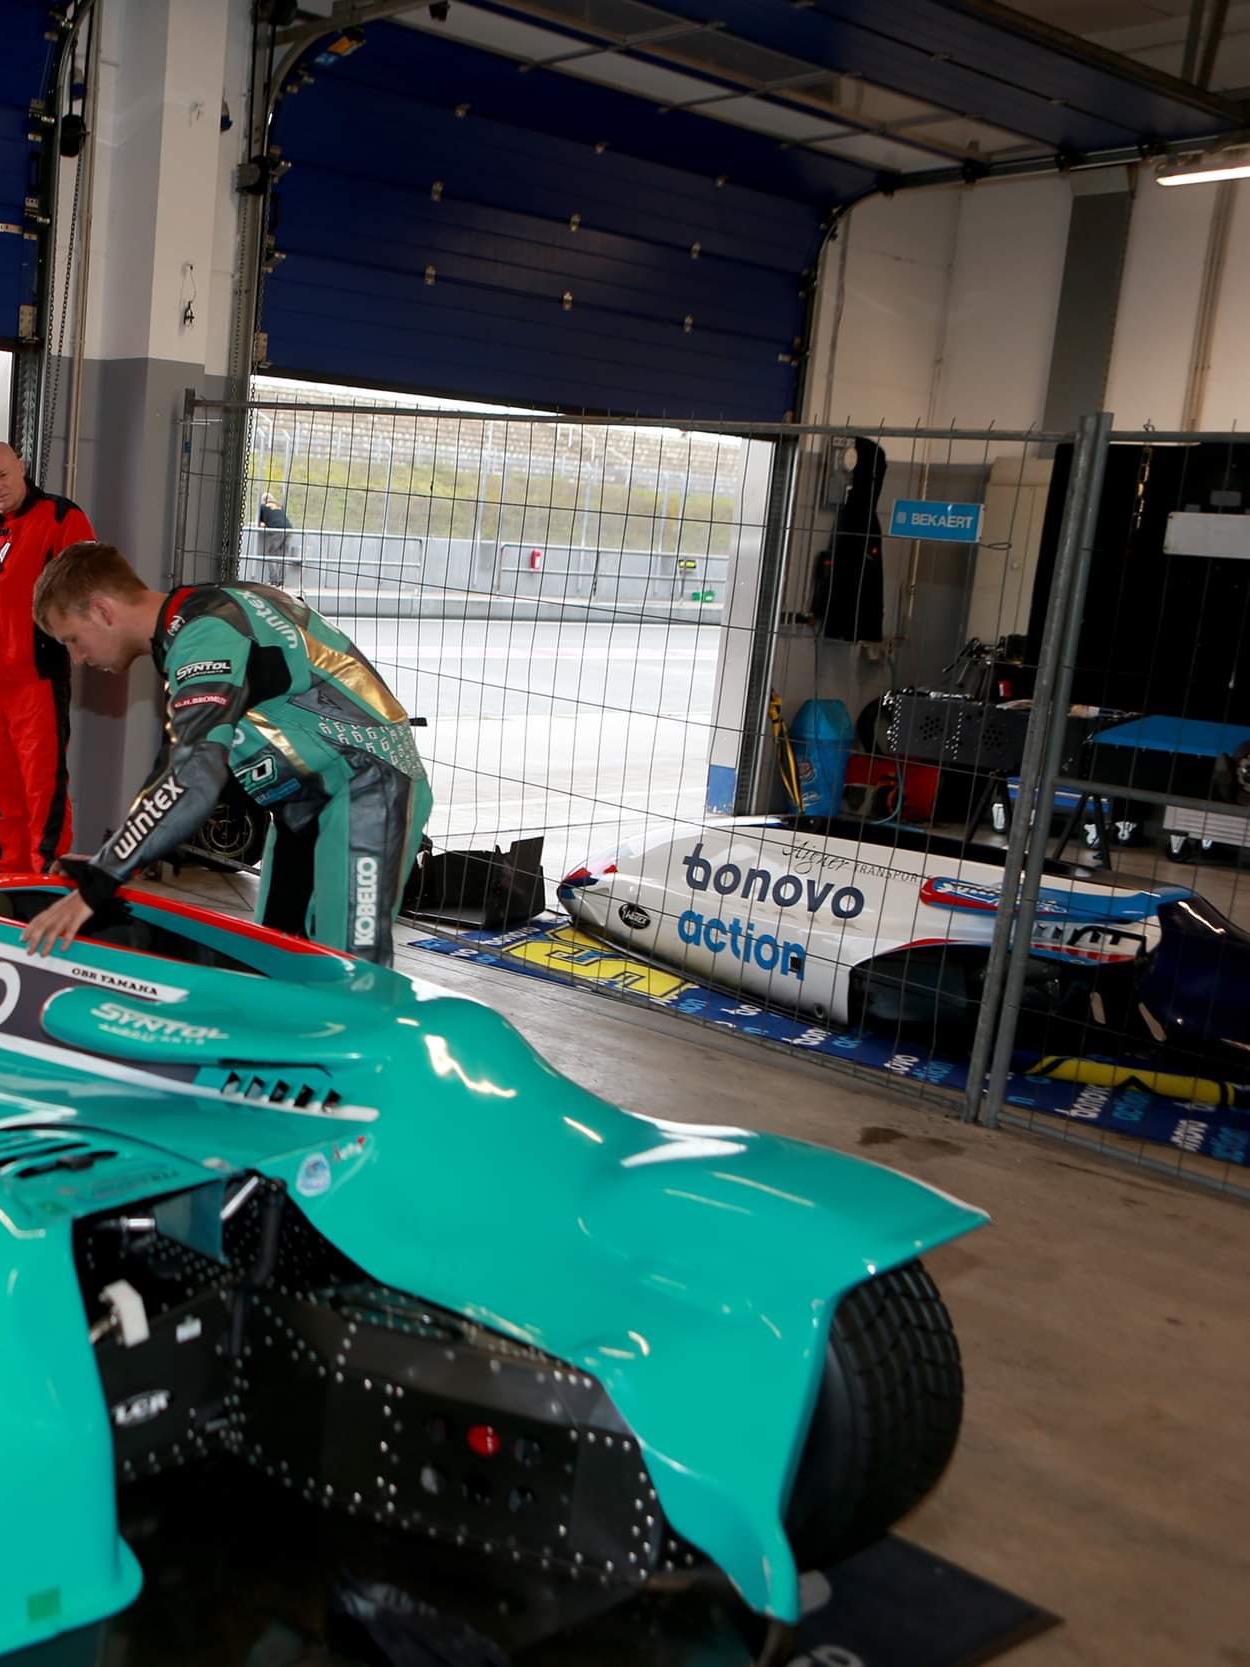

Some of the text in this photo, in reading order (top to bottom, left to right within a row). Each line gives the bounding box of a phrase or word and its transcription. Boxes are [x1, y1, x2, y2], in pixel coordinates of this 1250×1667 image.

[911, 513, 974, 529] BEKAERT
[237, 590, 299, 650] wintex
[177, 661, 231, 681] SYNTOL
[113, 776, 185, 861] wintex
[353, 857, 378, 946] KOBELCO
[682, 843, 865, 920] bonovo
[677, 909, 807, 982] action
[100, 975, 159, 996] YAMAHA
[90, 1002, 230, 1040] SYNTOL
